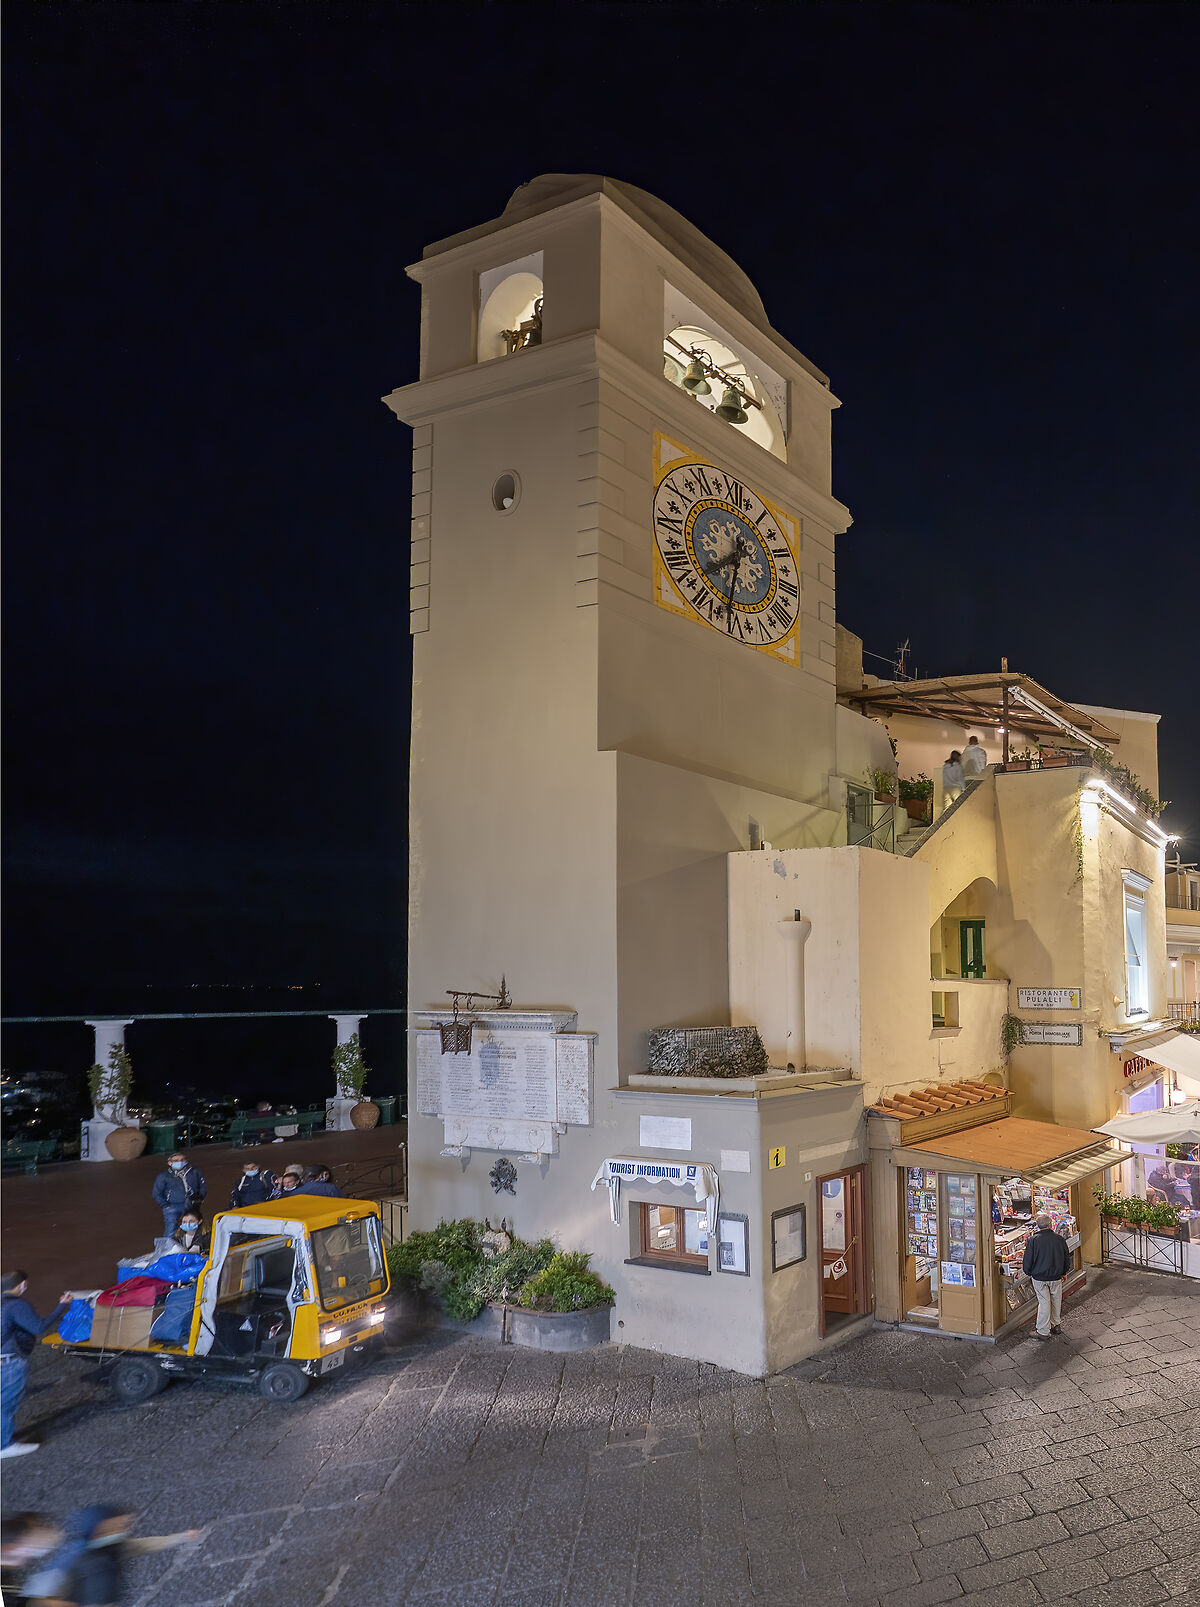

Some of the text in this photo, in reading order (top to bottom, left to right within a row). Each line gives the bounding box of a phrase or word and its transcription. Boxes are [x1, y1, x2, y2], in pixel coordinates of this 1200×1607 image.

[664, 476, 693, 510] X
[688, 468, 713, 496] XI
[722, 473, 743, 509] XII
[657, 508, 683, 536] IX
[755, 509, 768, 525] I
[773, 548, 790, 558] II
[779, 578, 797, 599] III
[757, 616, 773, 641] V
[608, 1162, 681, 1179] TOURIST INFORMATION
